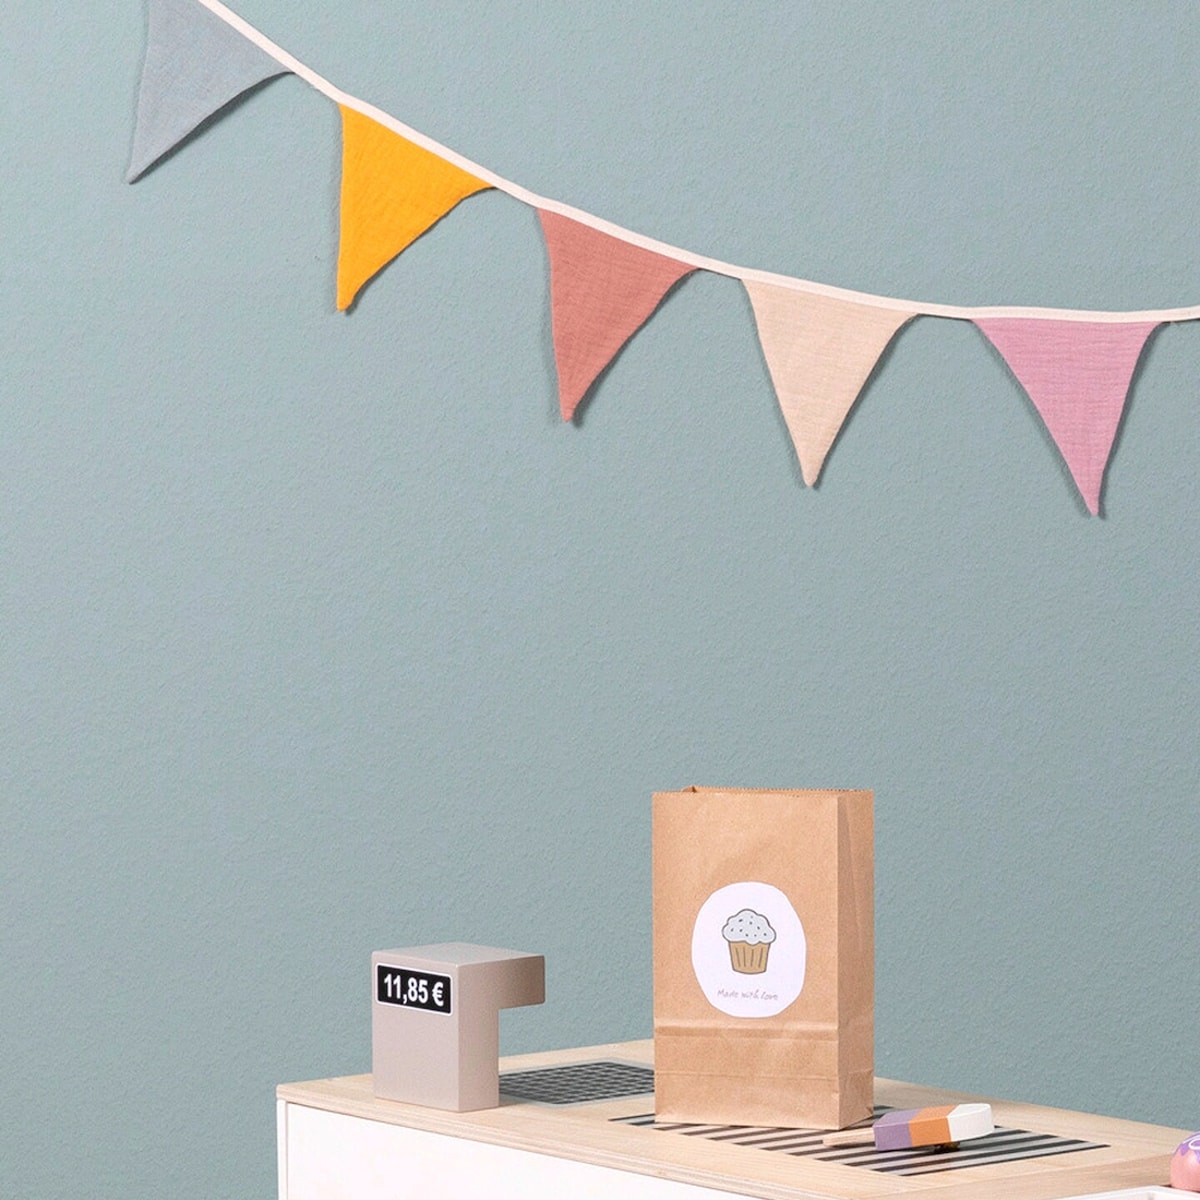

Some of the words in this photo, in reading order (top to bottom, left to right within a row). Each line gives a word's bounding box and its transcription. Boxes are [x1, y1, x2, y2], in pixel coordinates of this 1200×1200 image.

[384, 973, 428, 1004] 11,85
[432, 981, 444, 1007] €
[717, 988, 739, 998] Made
[741, 989, 759, 999] with
